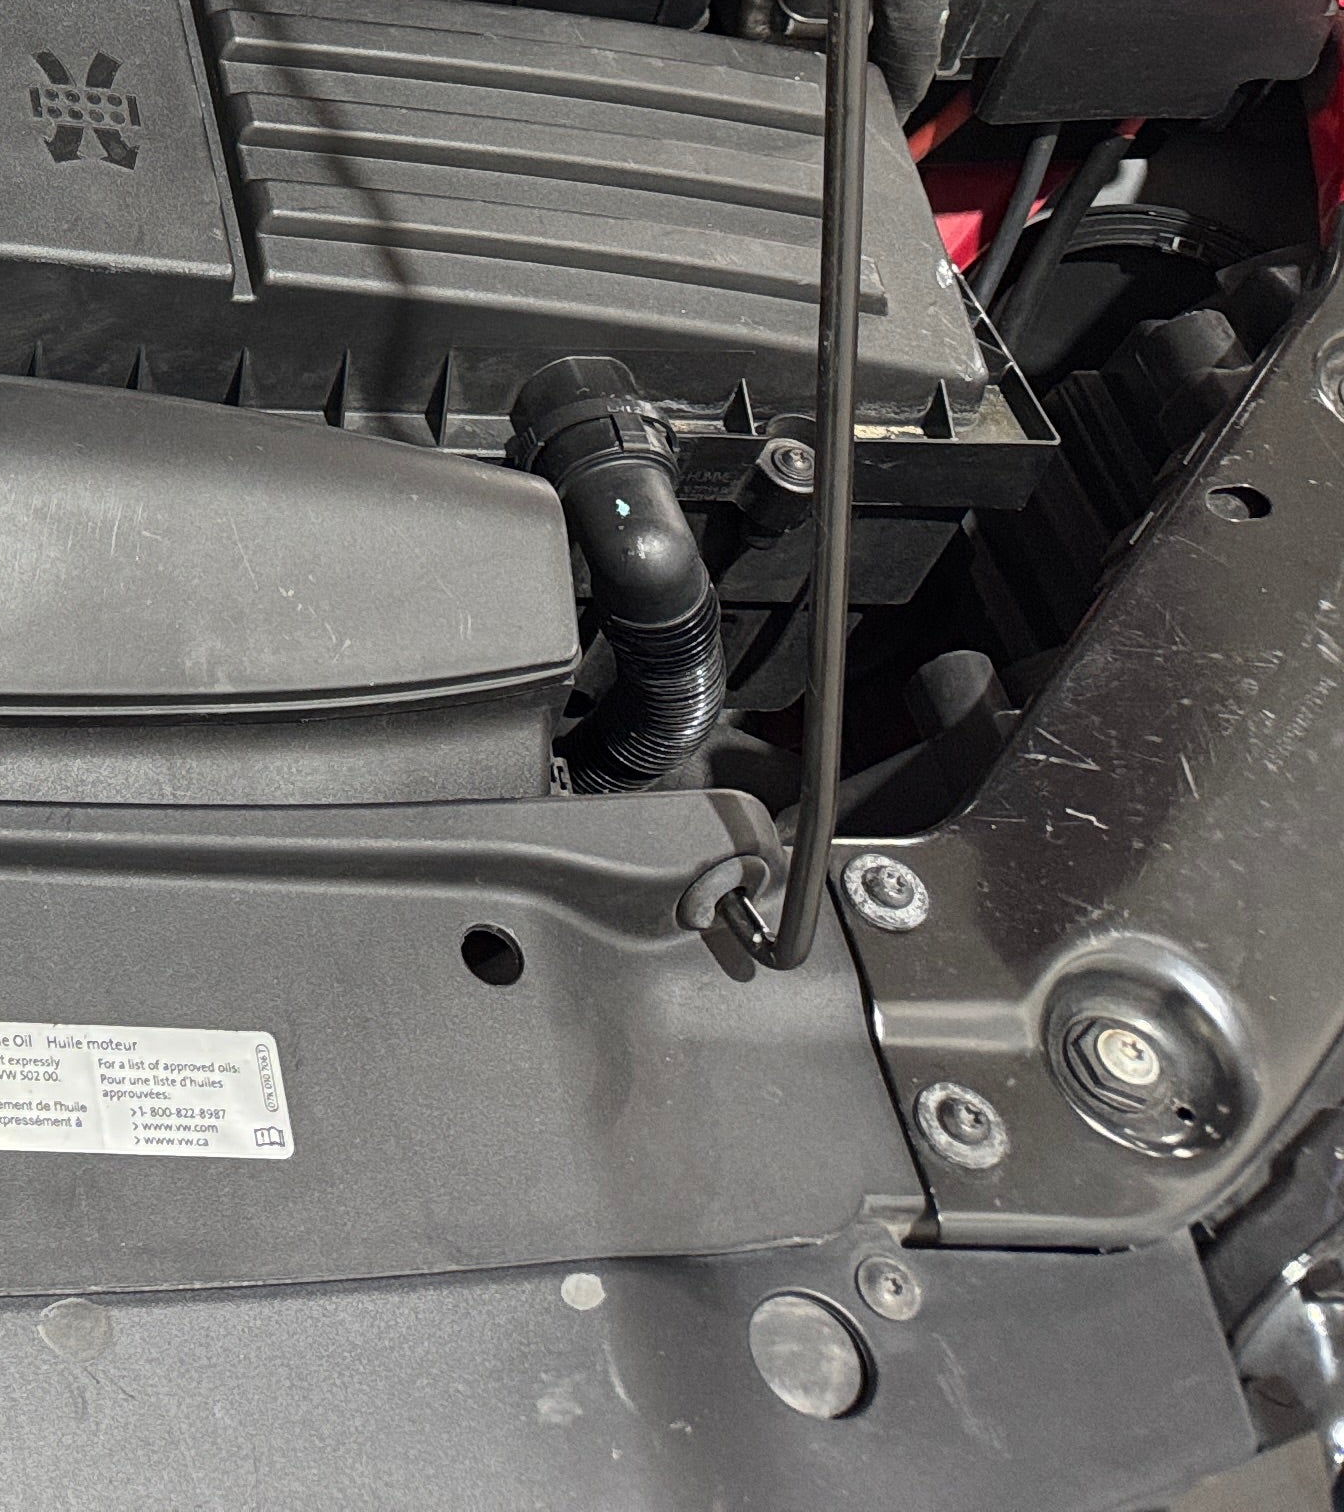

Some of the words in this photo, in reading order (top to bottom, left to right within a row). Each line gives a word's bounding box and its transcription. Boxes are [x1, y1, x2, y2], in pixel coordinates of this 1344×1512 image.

[13, 1034, 33, 1047] Oil
[47, 1035, 83, 1049] Huile
[86, 1039, 138, 1052] moteur
[8, 1055, 61, 1070] expressly
[97, 1058, 116, 1070] For
[118, 1061, 125, 1070] a
[128, 1059, 145, 1071] list
[148, 1060, 160, 1071] of
[162, 1061, 215, 1075] approved
[217, 1062, 241, 1074] oils:
[20, 1070, 40, 1081] 502
[100, 1074, 126, 1086] Pour
[128, 1076, 150, 1086] une
[153, 1075, 177, 1087] liste
[179, 1076, 224, 1089] d'huiles
[36, 1100, 51, 1112] de
[75, 1115, 83, 1128] à
[141, 1122, 219, 1134] www.vw.com
[144, 1136, 210, 1147] www.vw.ca
